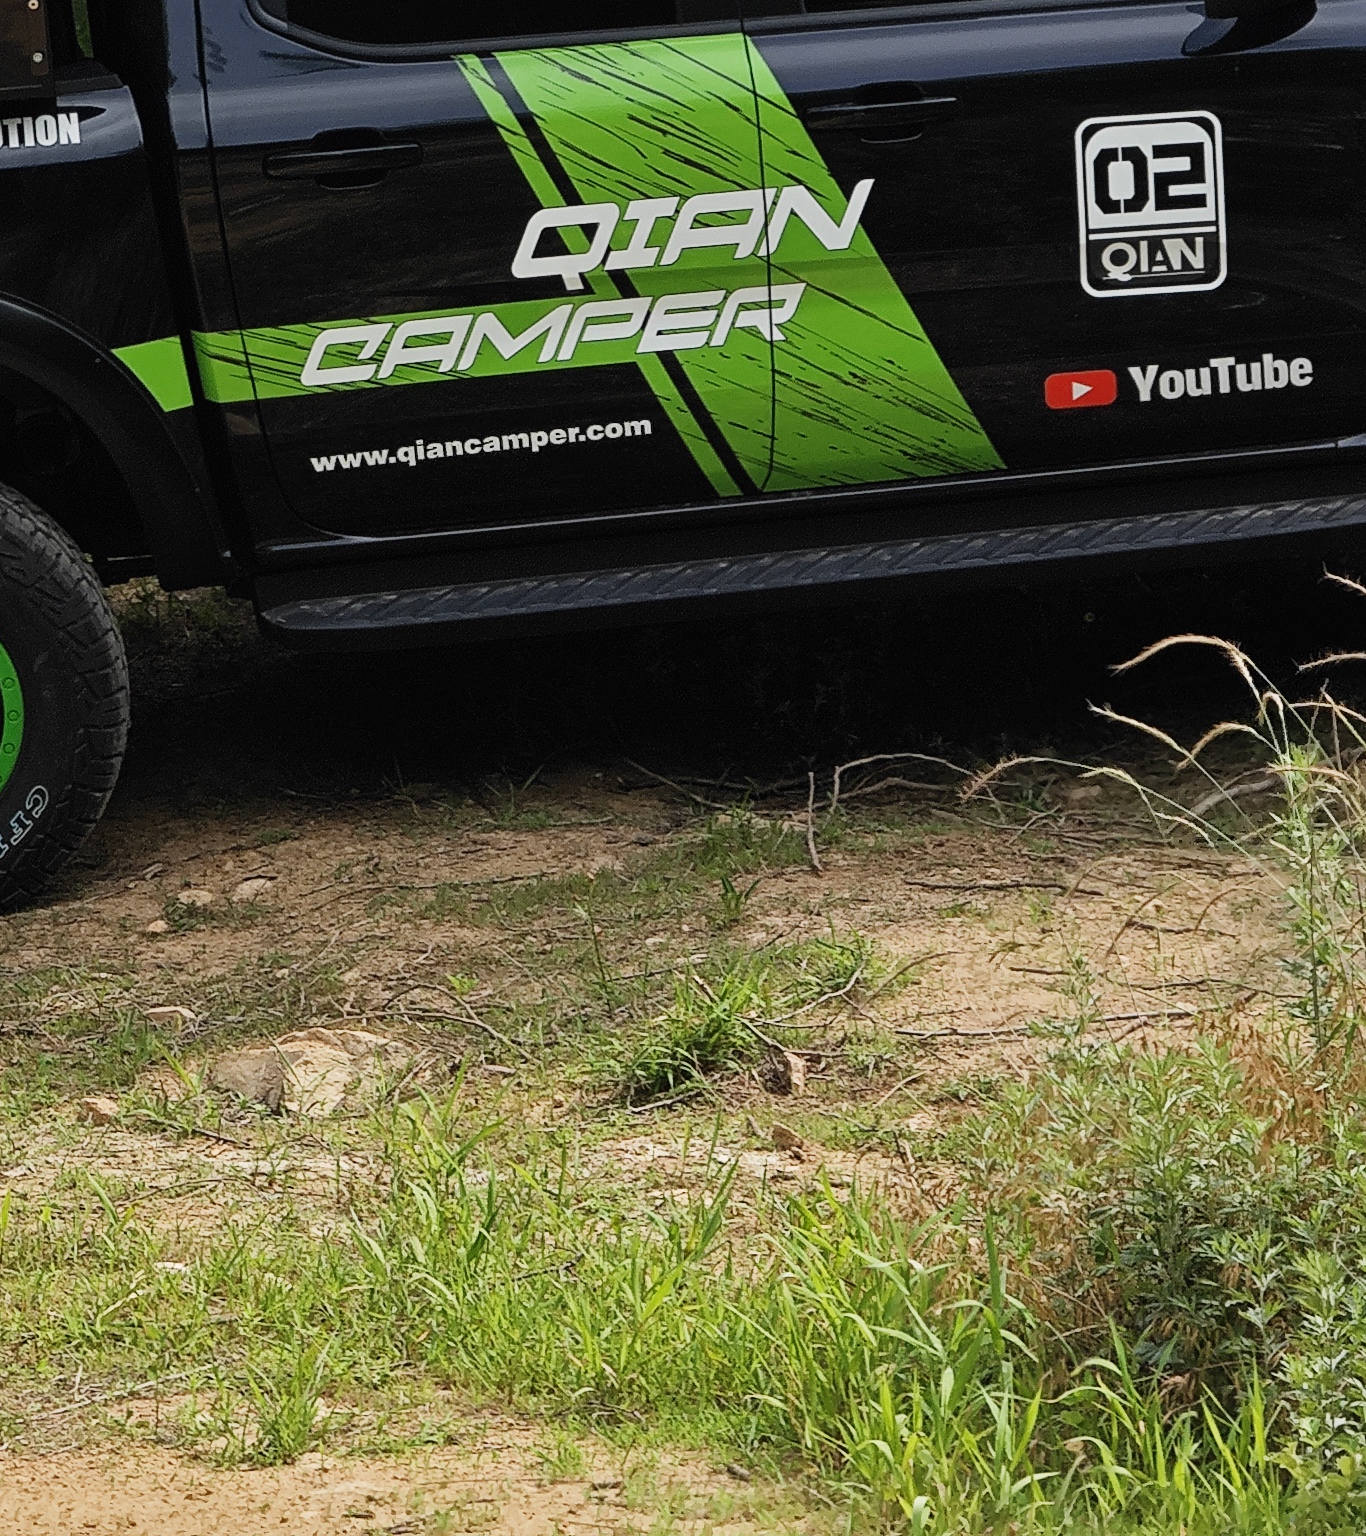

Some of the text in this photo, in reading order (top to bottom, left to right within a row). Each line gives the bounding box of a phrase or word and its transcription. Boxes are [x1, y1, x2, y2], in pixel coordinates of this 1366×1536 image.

[1093, 141, 1209, 214] 02
[511, 178, 874, 290] QIAN
[1101, 236, 1205, 282] QIAN
[300, 282, 806, 387] CAMPER
[1127, 352, 1314, 402] YouTube
[310, 418, 653, 473] www.qiancamper.com
